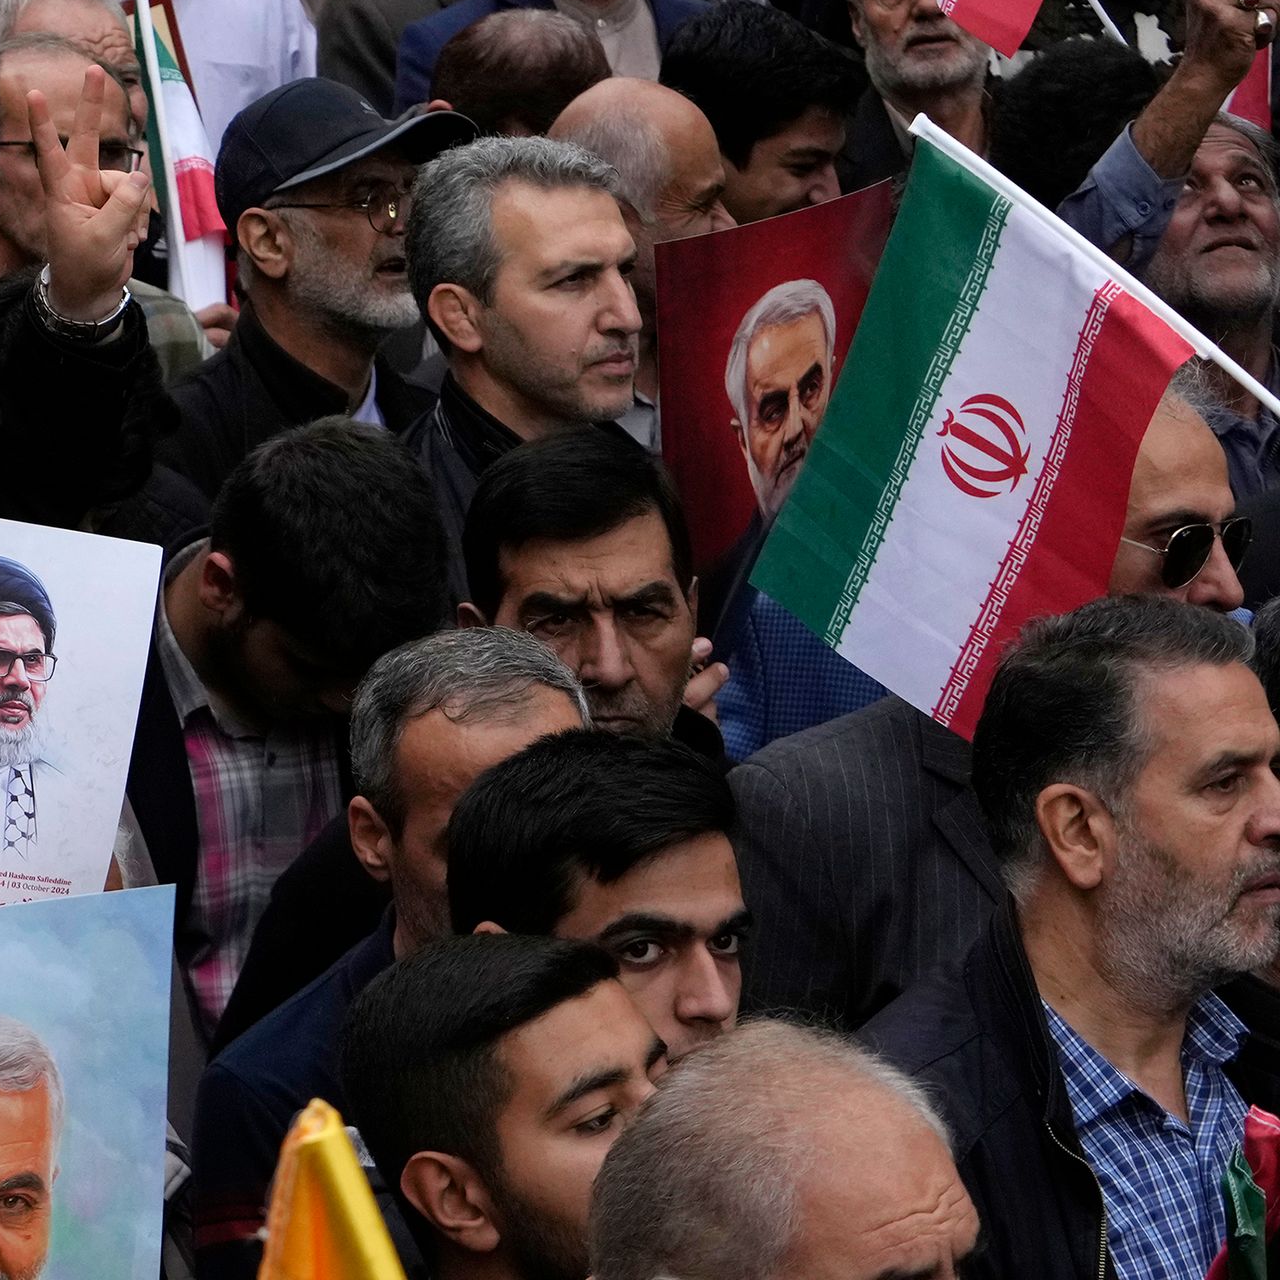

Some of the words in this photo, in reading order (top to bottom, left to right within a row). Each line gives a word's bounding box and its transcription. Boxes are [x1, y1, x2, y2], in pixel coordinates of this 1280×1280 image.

[9, 871, 36, 881] Hashem
[37, 875, 72, 886] Safieddine
[11, 881, 21, 889] 03
[22, 883, 50, 893] October
[51, 886, 70, 895] 2024
